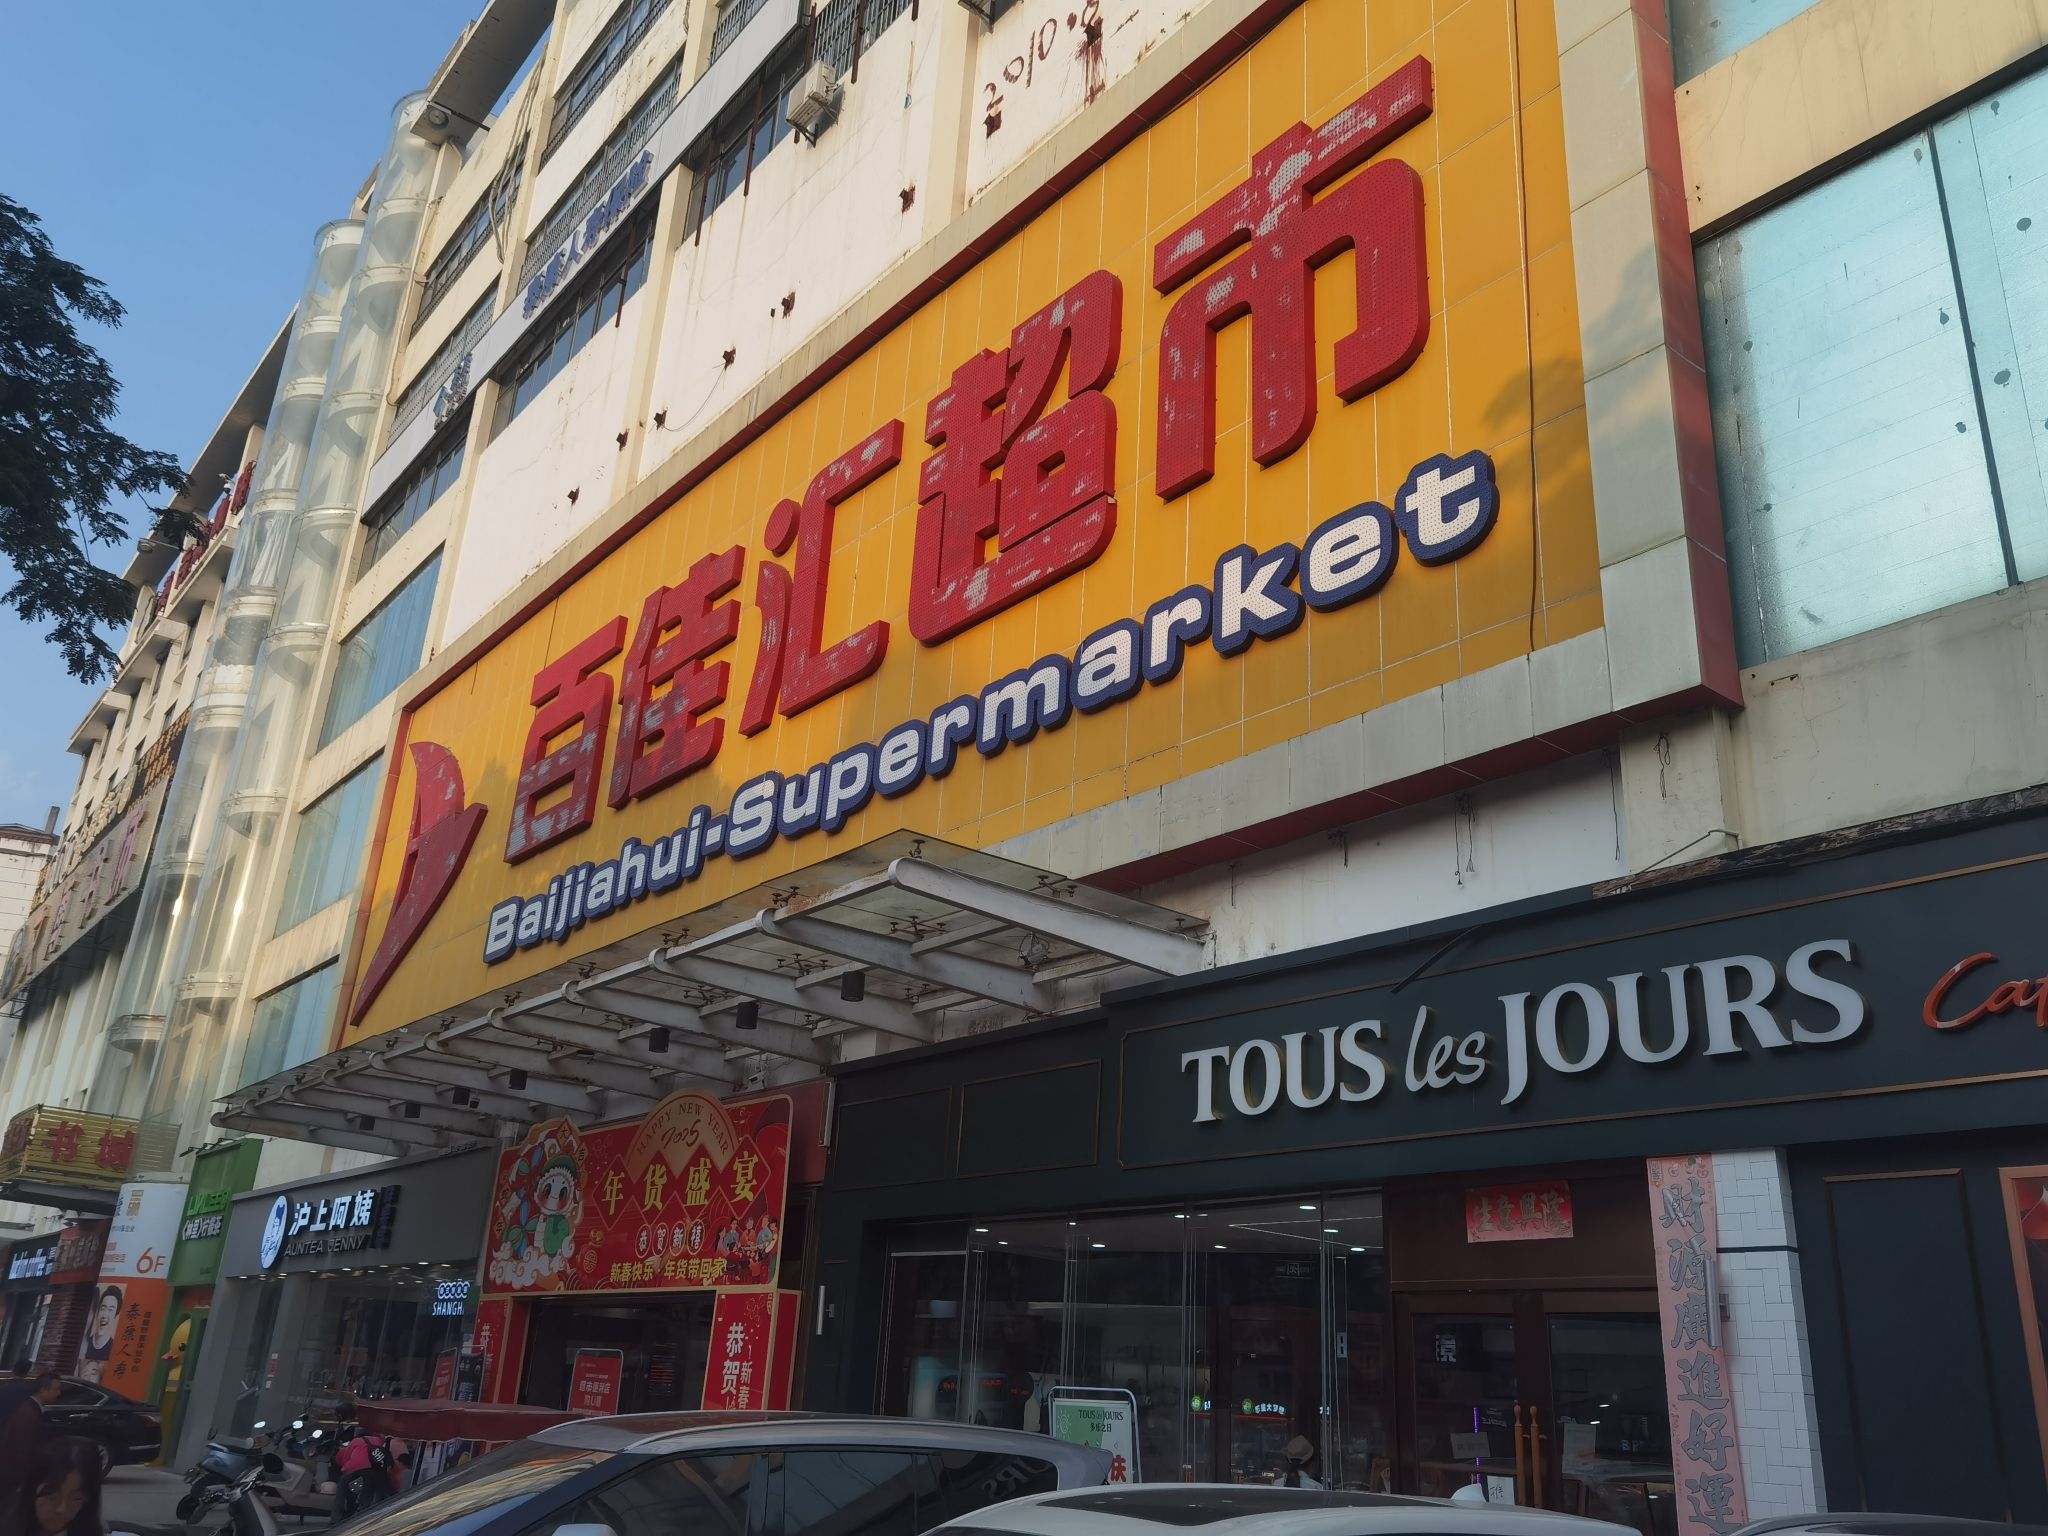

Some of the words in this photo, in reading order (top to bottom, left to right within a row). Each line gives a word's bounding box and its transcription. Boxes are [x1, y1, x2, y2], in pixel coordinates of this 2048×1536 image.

[504, 54, 1433, 864] 百佳汇超市
[484, 449, 1500, 965] Baijiahui-Supermarket
[1181, 1019, 1387, 1123] TOUS
[1405, 1004, 1488, 1092] les
[1497, 938, 1865, 1106] JOURS
[636, 1108, 672, 1156] HAPPY
[679, 1102, 704, 1116] NEW
[707, 1113, 729, 1156] YEAR
[661, 1118, 701, 1150] 2025
[600, 1150, 759, 1216] 年货盛宴
[288, 1188, 376, 1236] 沪上阿姨
[136, 1246, 167, 1275] 6F
[284, 1239, 323, 1257] AUNTEA
[638, 1224, 702, 1252] 恭贺新禧
[1078, 1409, 1096, 1419] TOUS
[1102, 1409, 1124, 1421] JOURS
